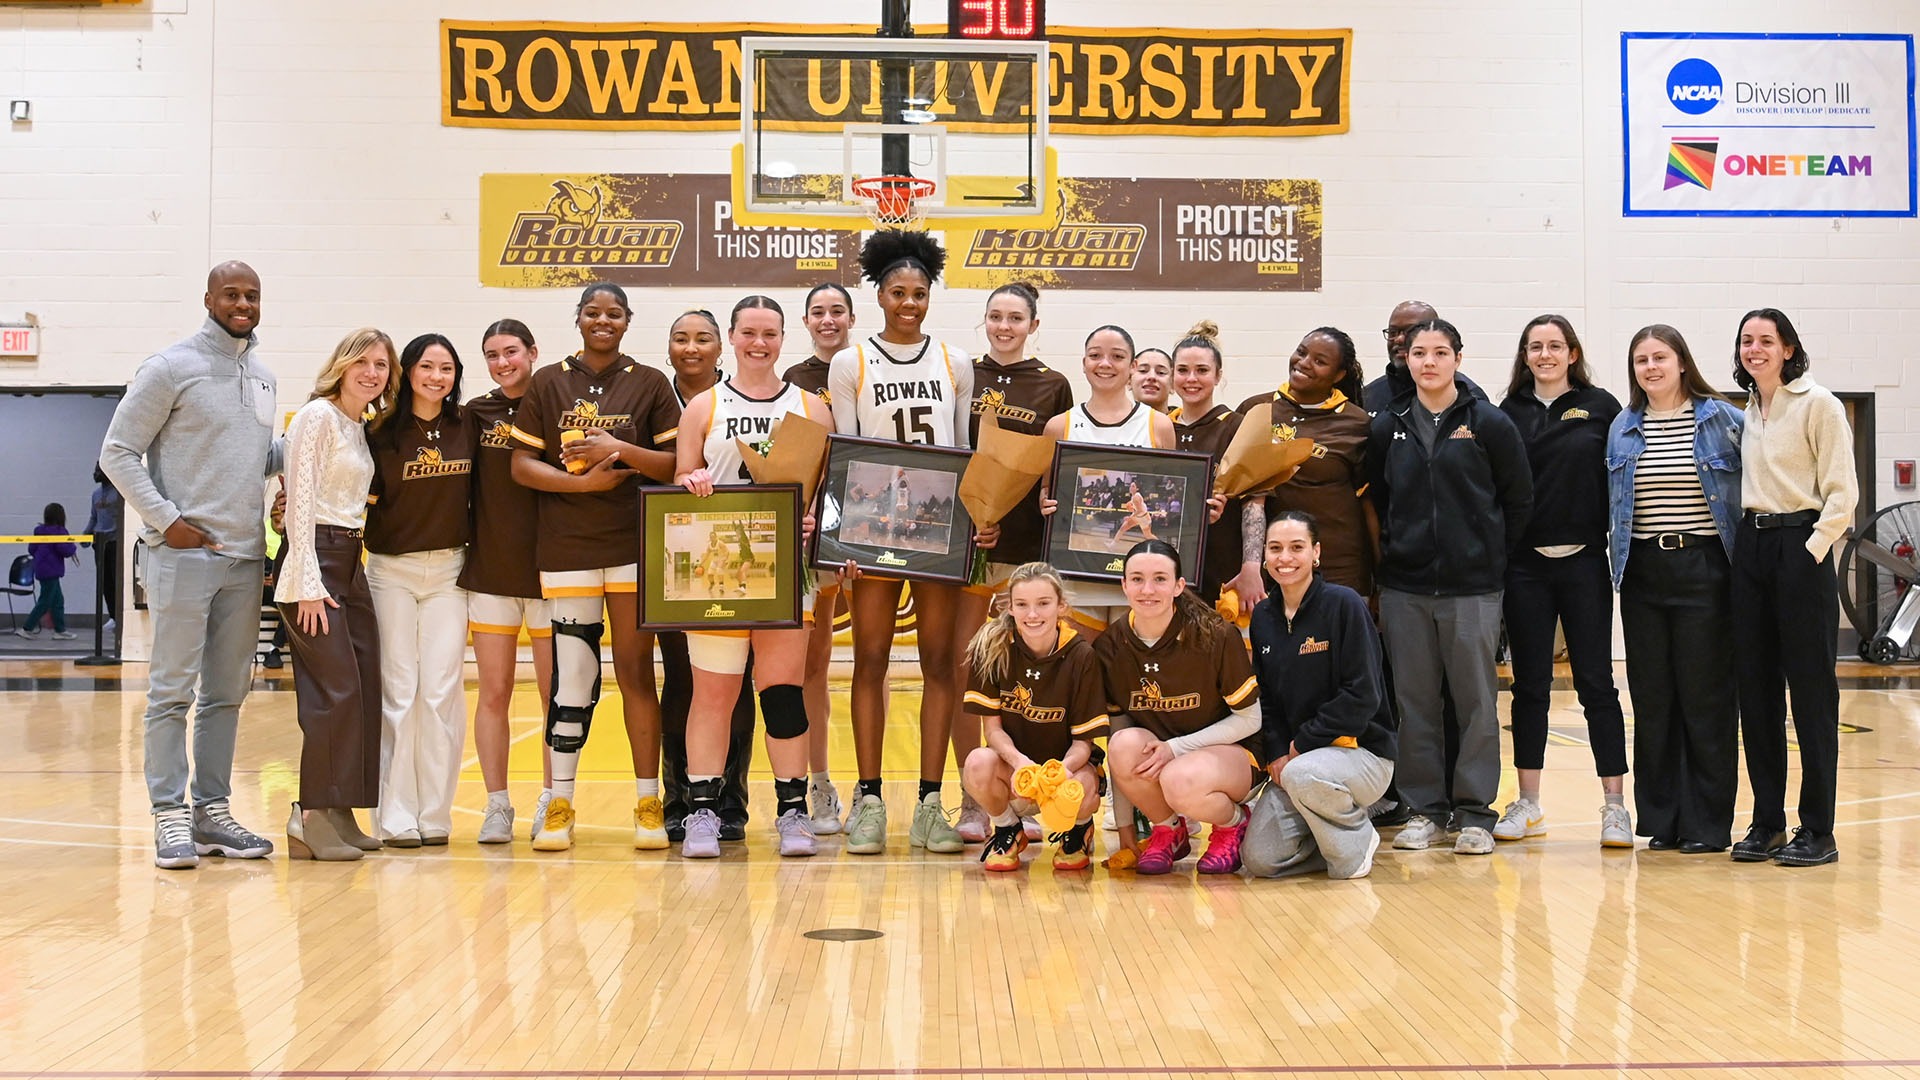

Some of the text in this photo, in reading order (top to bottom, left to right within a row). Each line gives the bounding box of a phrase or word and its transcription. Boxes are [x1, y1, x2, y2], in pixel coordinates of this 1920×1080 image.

[962, 0, 1032, 34] 30
[455, 36, 766, 114] ROWAN
[1672, 82, 1850, 104] NCAA Division III
[1723, 154, 1872, 176] ONETEAM
[512, 217, 680, 248] Rowan
[1177, 205, 1298, 236] PROTECT
[505, 250, 670, 264] VOLLEYBALL
[713, 234, 843, 258] THIS HOUSE.
[1176, 238, 1304, 262] THIS HOUSE.
[968, 252, 1130, 267] BASKETBALL
[3, 331, 30, 351] EXIT
[873, 380, 943, 407] ROWAN
[726, 416, 780, 440] ROW
[892, 405, 935, 444] 15
